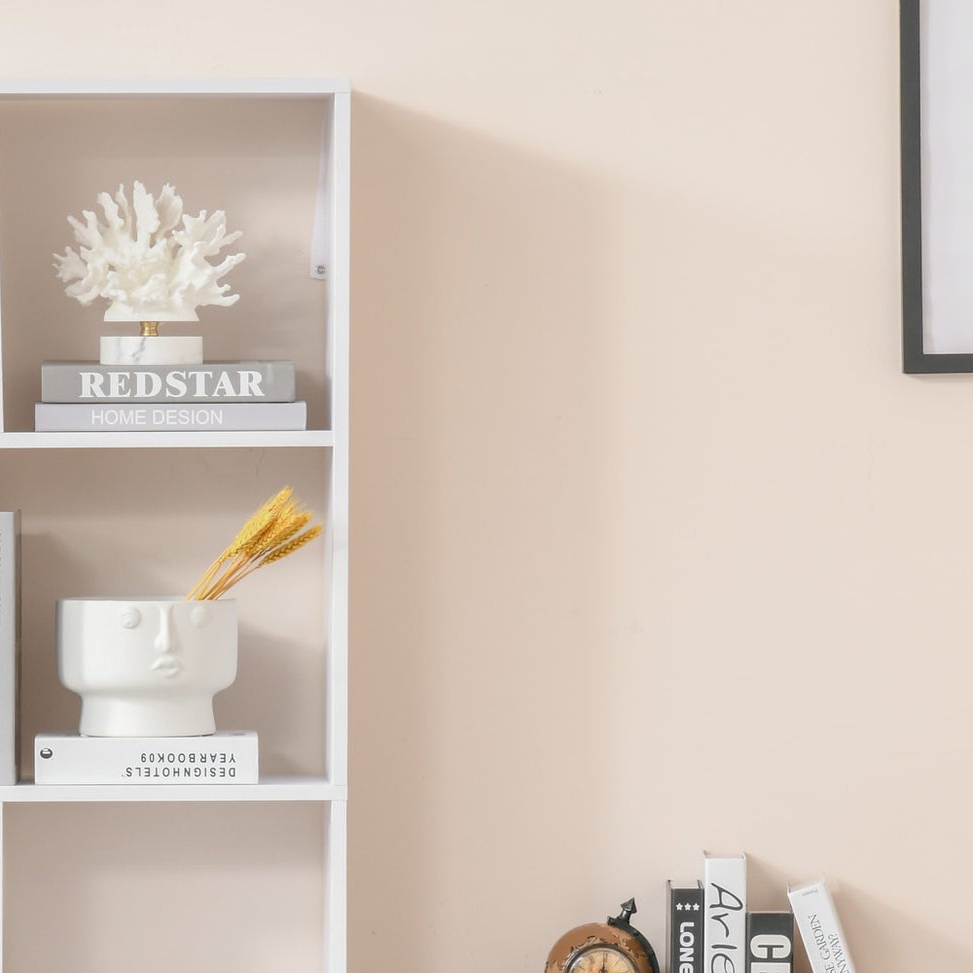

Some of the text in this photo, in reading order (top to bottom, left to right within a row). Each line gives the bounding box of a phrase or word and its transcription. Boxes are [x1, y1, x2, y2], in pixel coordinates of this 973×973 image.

[78, 370, 265, 398] REDSTAR
[91, 409, 223, 425] HOME DESIGN
[807, 913, 831, 961] GARDEN
